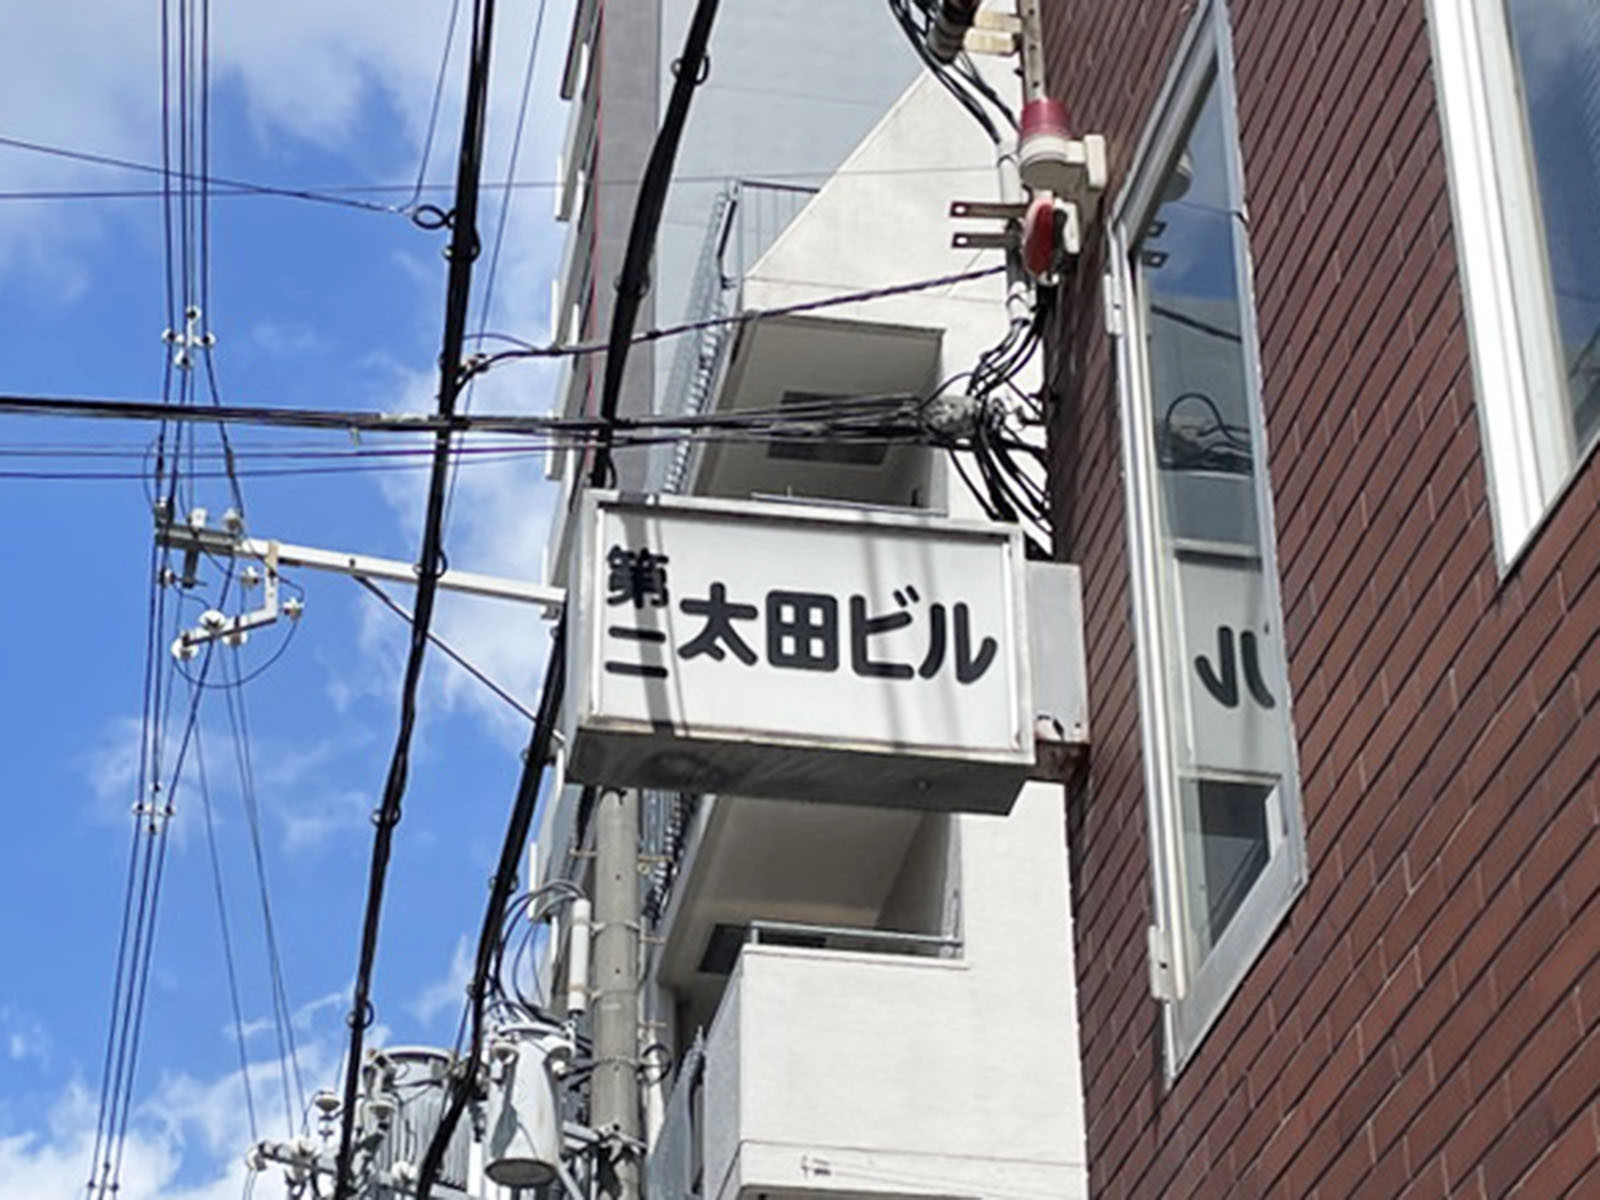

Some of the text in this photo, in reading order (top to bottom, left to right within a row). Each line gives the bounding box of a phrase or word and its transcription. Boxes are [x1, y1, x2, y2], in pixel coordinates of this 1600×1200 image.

[605, 545, 669, 678] 第二
[677, 582, 997, 684] 太田ビル
